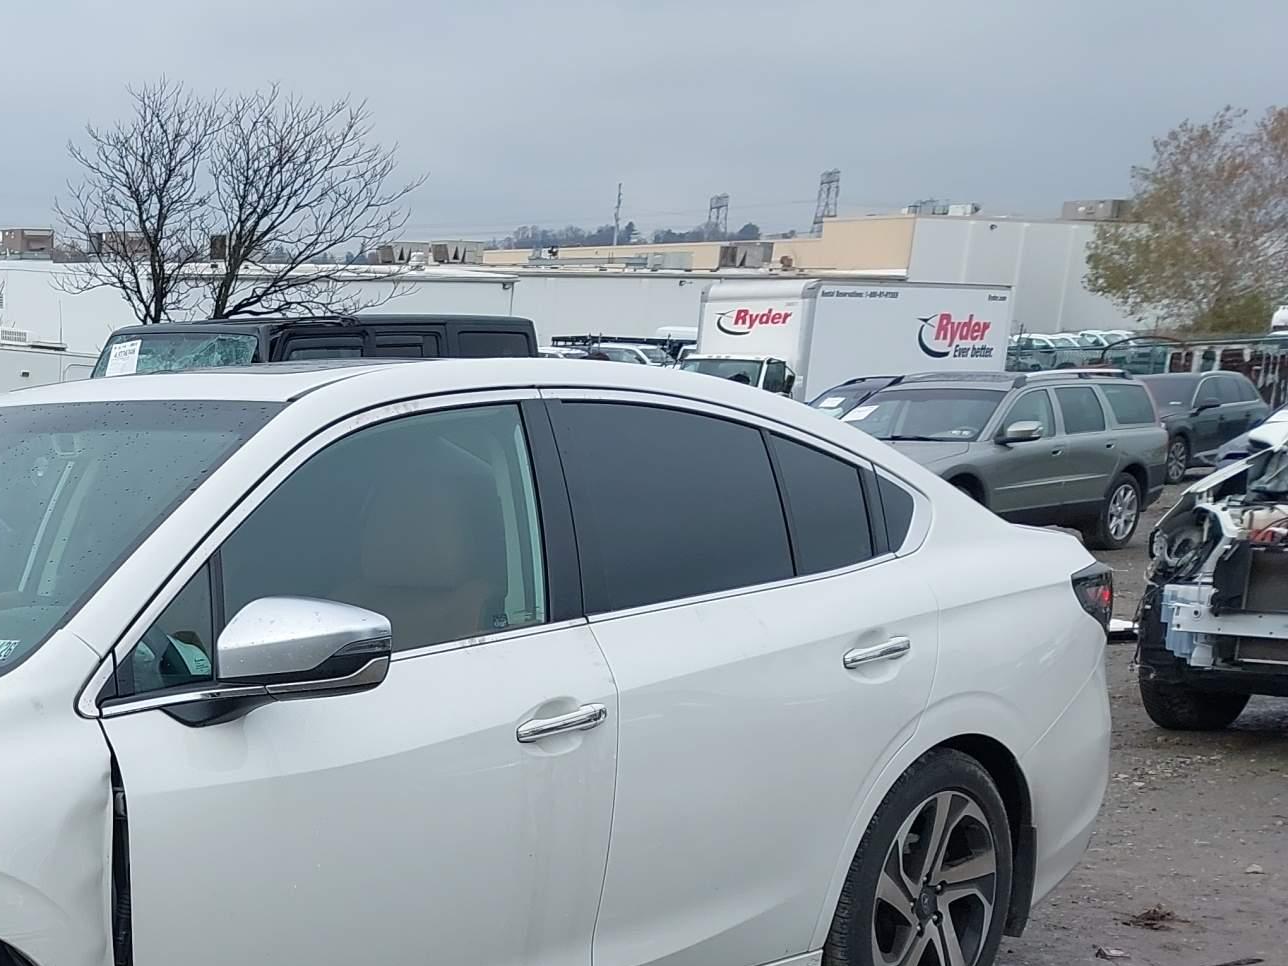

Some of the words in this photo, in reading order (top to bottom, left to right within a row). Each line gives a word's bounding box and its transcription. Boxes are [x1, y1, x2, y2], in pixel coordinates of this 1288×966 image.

[734, 308, 793, 330] Ryder
[934, 313, 991, 347] Ryder
[953, 344, 970, 358] Ever
